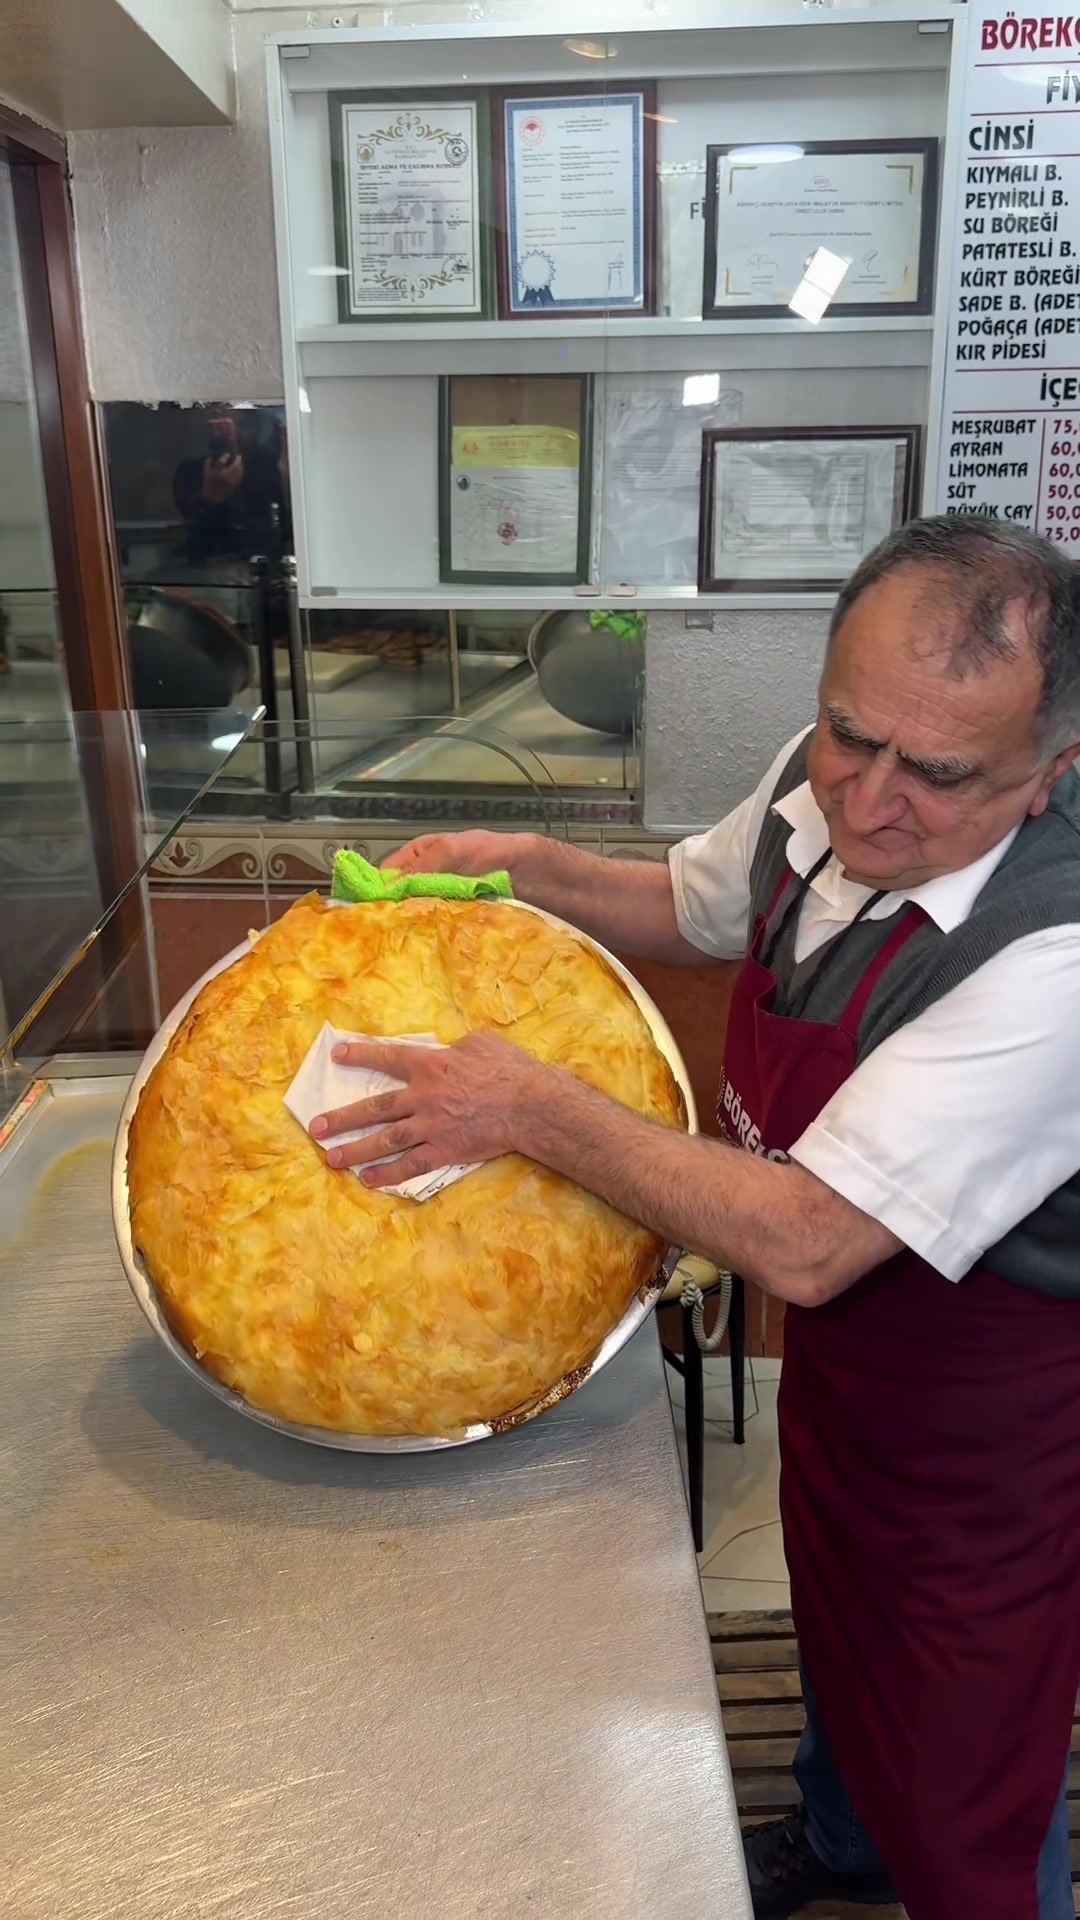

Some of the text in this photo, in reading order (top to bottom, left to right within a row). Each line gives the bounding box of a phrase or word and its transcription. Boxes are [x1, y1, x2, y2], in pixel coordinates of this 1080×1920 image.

[969, 119, 1034, 151] CİNSİ
[967, 164, 1062, 185] KIYMALI B.
[965, 186, 1069, 210] PEYNİRLİ B.
[963, 211, 1058, 235] SU BÖREĞİ
[962, 237, 1077, 261] PATATESLİ B.
[960, 264, 1080, 288] KÜRT BÖREĞİ
[958, 295, 1003, 313] SADE
[1009, 295, 1027, 311] B.
[957, 316, 1028, 340] POĞAÇA
[956, 339, 1046, 361] KIR PİDESİ
[1040, 372, 1080, 408] İÇE
[952, 419, 1080, 439] MEŞRUBAT 75,
[950, 441, 1080, 458] AYRAN 60,
[949, 460, 1028, 479] LİMONATA
[947, 481, 977, 499] SÜT
[1004, 504, 1033, 521] ÇAY
